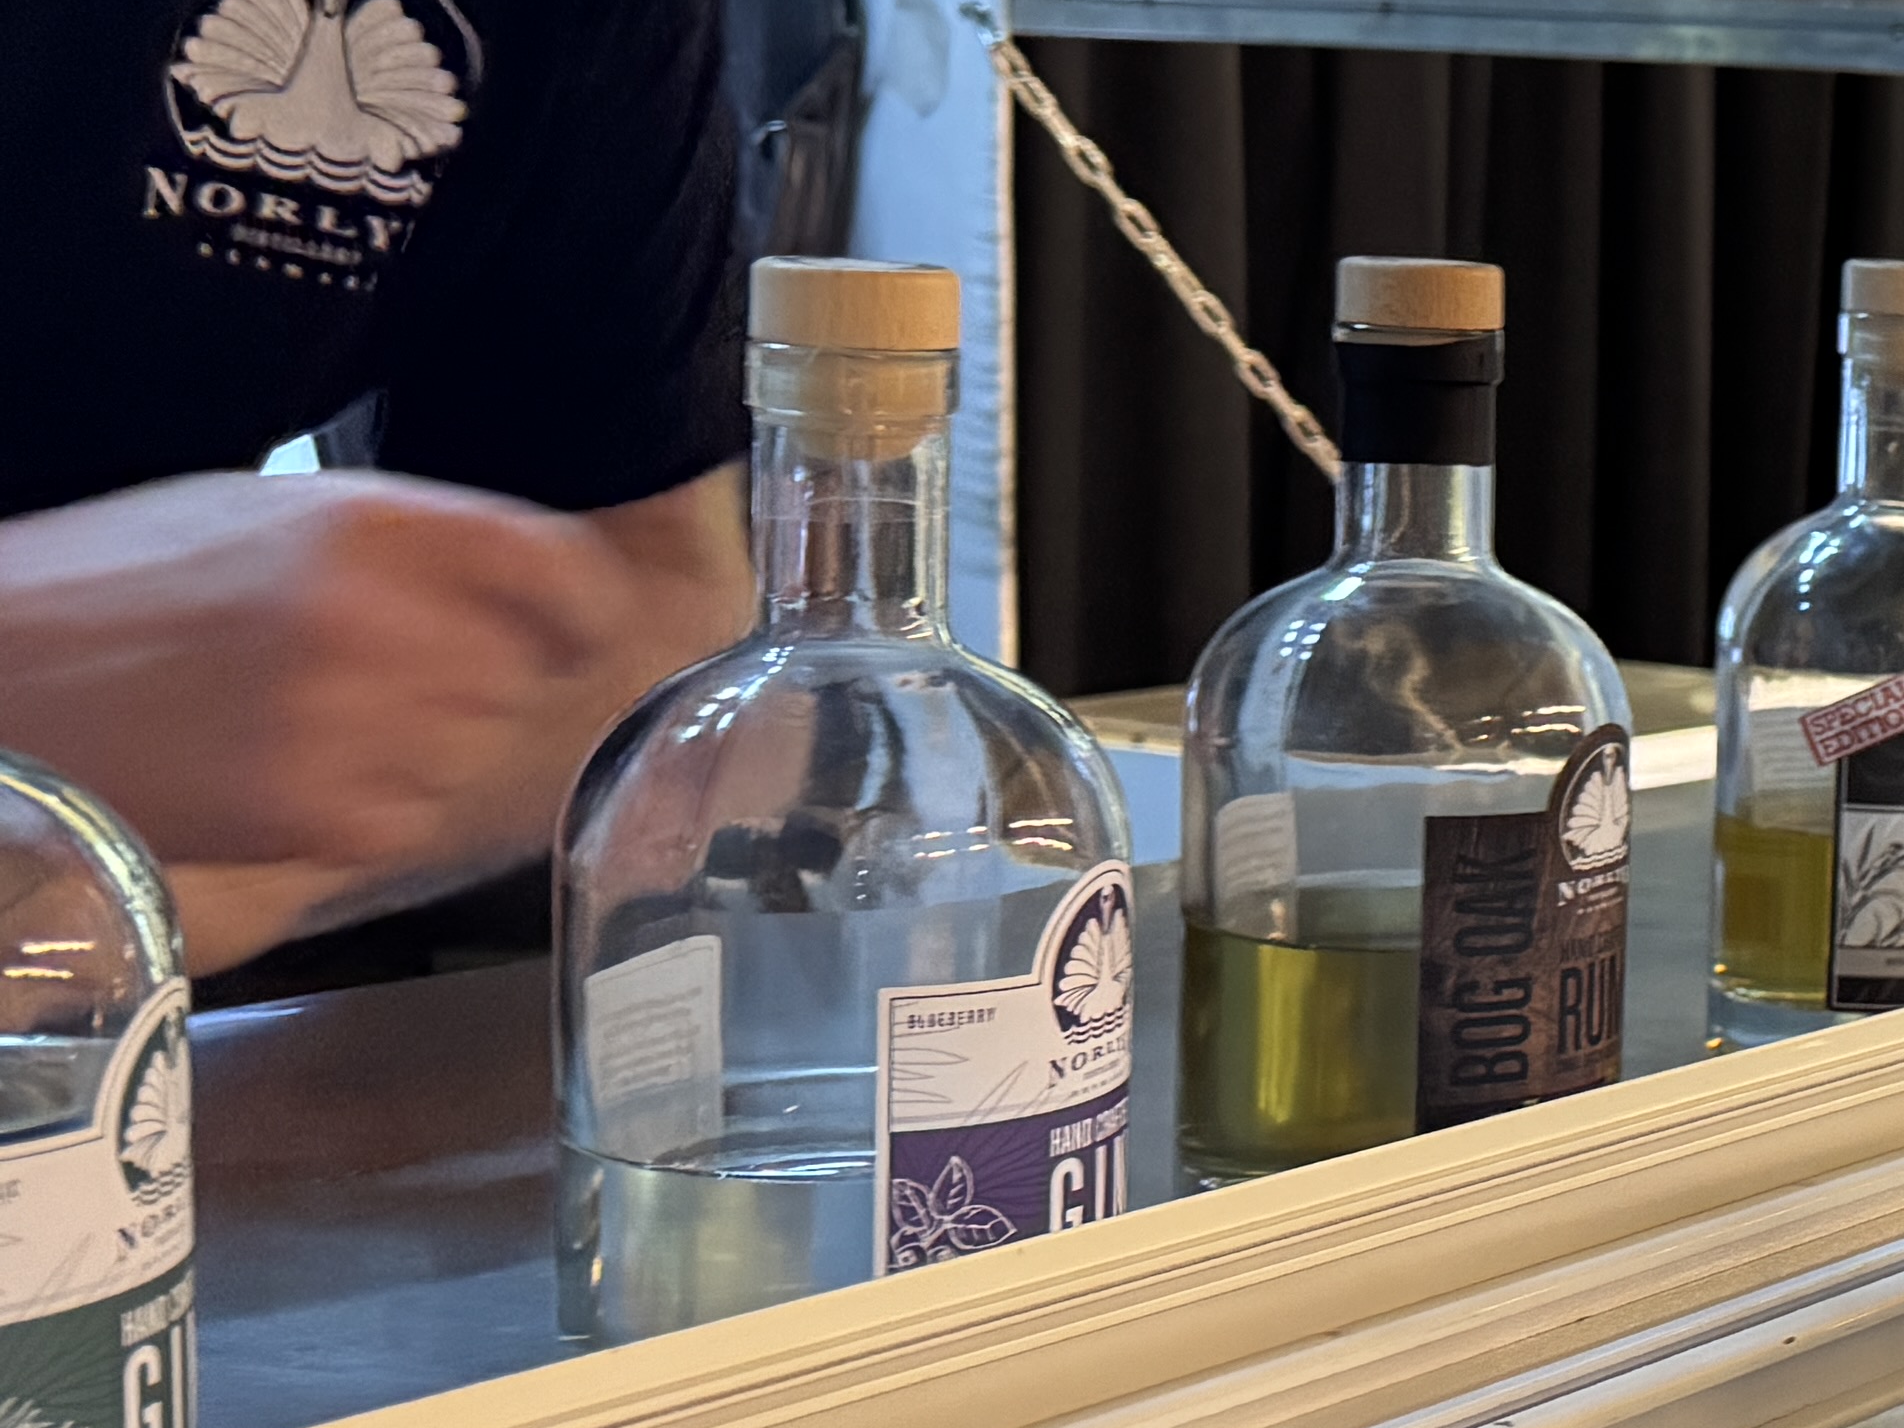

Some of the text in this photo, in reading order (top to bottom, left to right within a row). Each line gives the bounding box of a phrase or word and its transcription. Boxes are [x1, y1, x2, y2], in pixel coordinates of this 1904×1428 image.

[141, 165, 416, 254] NORLY
[1450, 848, 1538, 1087] BOG OAK
[906, 1007, 997, 1029] BLUEBERRY
